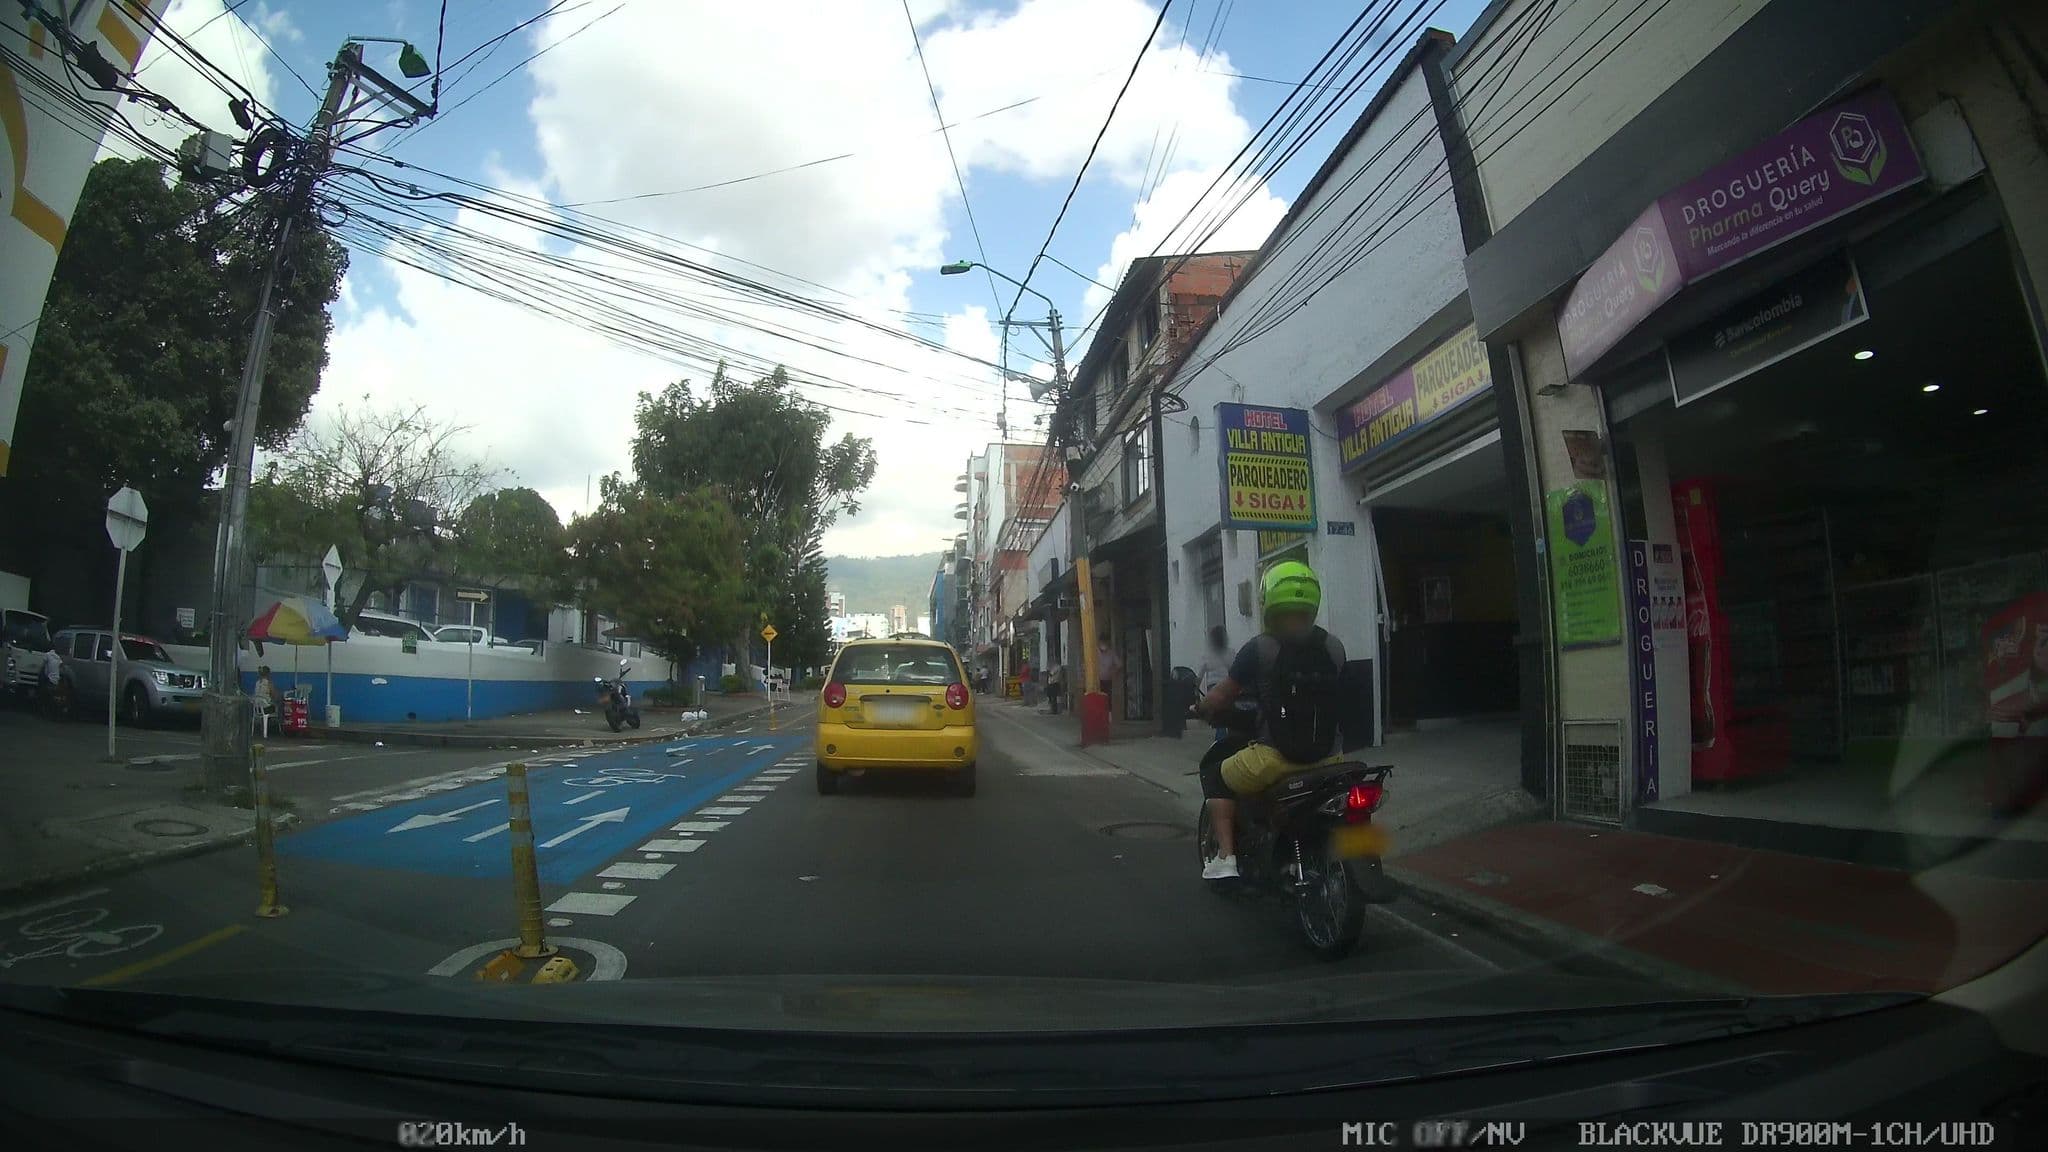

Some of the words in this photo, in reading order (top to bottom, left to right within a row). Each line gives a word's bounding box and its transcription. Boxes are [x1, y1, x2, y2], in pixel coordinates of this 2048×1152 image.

[1682, 144, 1816, 224] DROGUERÍA
[1689, 202, 1763, 248] Pharma
[1769, 169, 1830, 211] Query
[1707, 236, 1741, 256] Marcando
[1749, 218, 1784, 238] diferencia
[1804, 195, 1824, 213] salud
[1415, 335, 1488, 396] PARQUEADER
[1442, 376, 1477, 403] SIGA
[1227, 428, 1258, 450] VILLA
[1261, 431, 1306, 454] ANTIGUA
[1244, 409, 1287, 430] HOTEL
[1341, 428, 1368, 463] VILLA
[1369, 398, 1415, 447] ANTIGUA
[1230, 463, 1307, 491] PARQUEADERO
[1249, 493, 1294, 511] SIGA
[1634, 550, 1657, 793] DROGUERÍA
